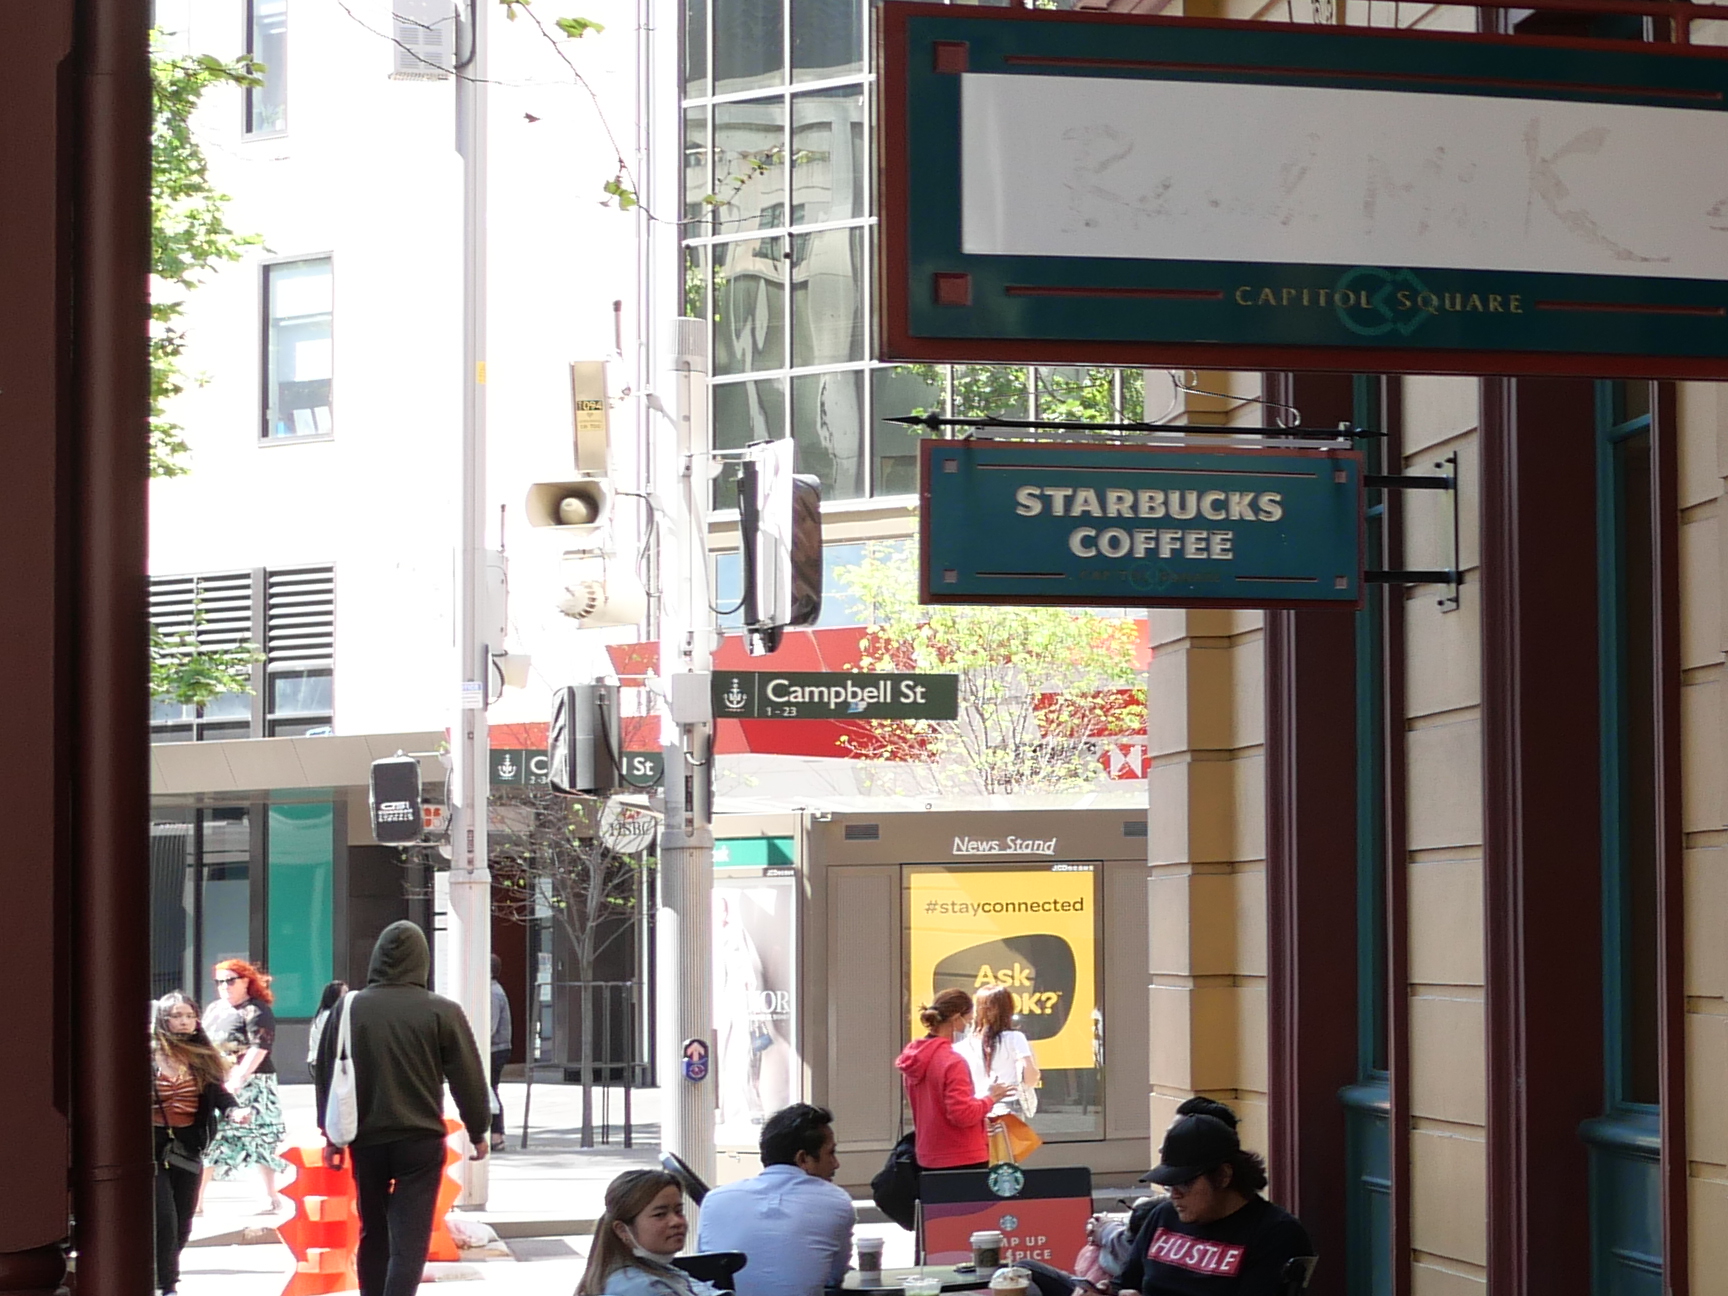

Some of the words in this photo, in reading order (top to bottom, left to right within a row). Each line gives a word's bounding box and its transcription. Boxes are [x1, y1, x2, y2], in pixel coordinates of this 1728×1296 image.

[1235, 286, 1374, 309] CAPITOL
[1396, 290, 1524, 315] SQUARE
[1015, 485, 1284, 522] STARBUCKS
[1067, 526, 1235, 560] COFFEE
[766, 679, 892, 710] Campbell
[900, 680, 927, 704] St
[633, 757, 654, 776] St
[953, 836, 1000, 854] News
[1006, 836, 1057, 854] Stand
[925, 897, 1084, 916] #stayconnected
[974, 962, 1031, 988] Ask
[1025, 1236, 1047, 1247] UP
[1152, 1235, 1239, 1270] HUSTLE
